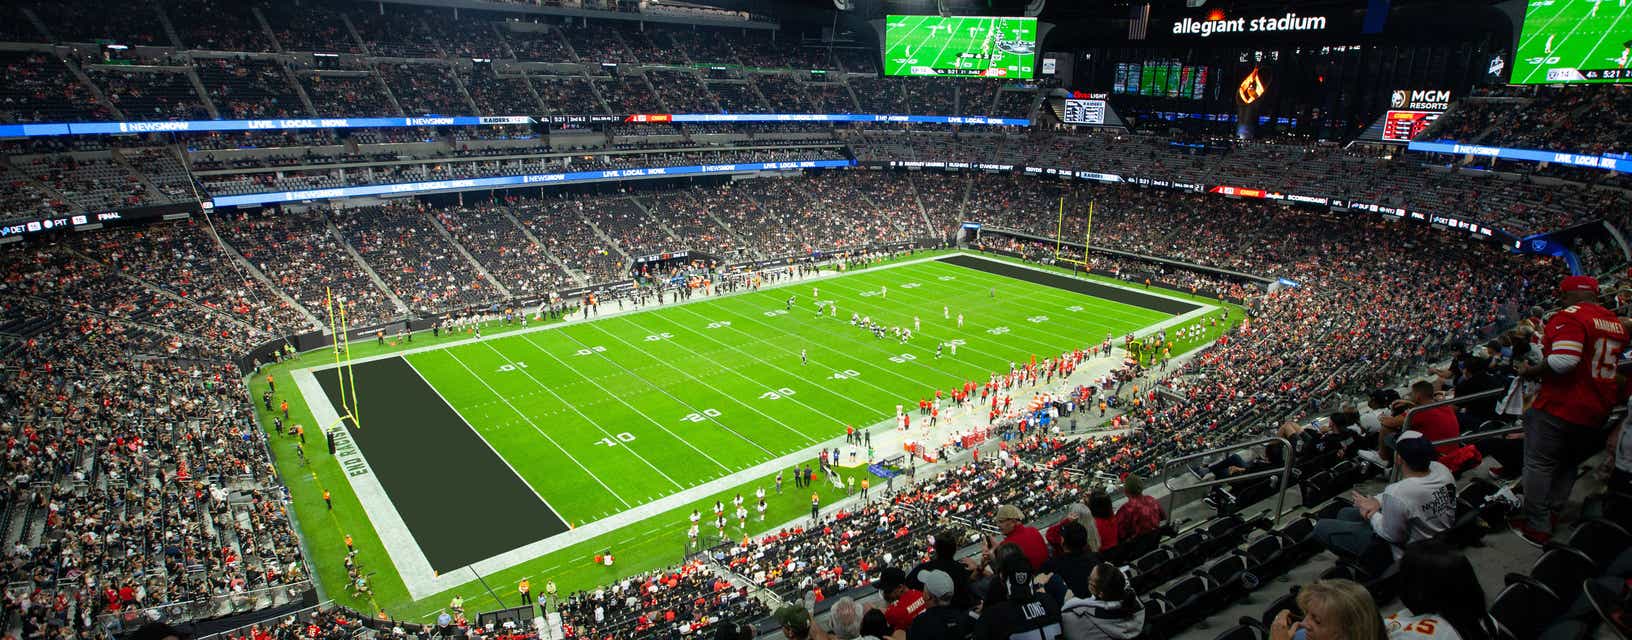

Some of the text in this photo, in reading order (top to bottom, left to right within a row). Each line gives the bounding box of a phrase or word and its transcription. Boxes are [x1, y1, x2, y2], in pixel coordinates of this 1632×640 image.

[1173, 13, 1326, 37] allegiant stadium
[1603, 70, 1620, 78] 5:21
[1412, 90, 1451, 102] MGM
[1410, 102, 1448, 110] RESORTS
[97, 212, 121, 221] FINAL
[10, 225, 25, 234] DET
[1591, 337, 1621, 379] 15
[833, 369, 861, 380] 40
[763, 387, 796, 400] 30
[685, 408, 722, 423] 20
[600, 431, 636, 447] 10
[344, 458, 369, 477] END
[1021, 601, 1046, 620] LONG
